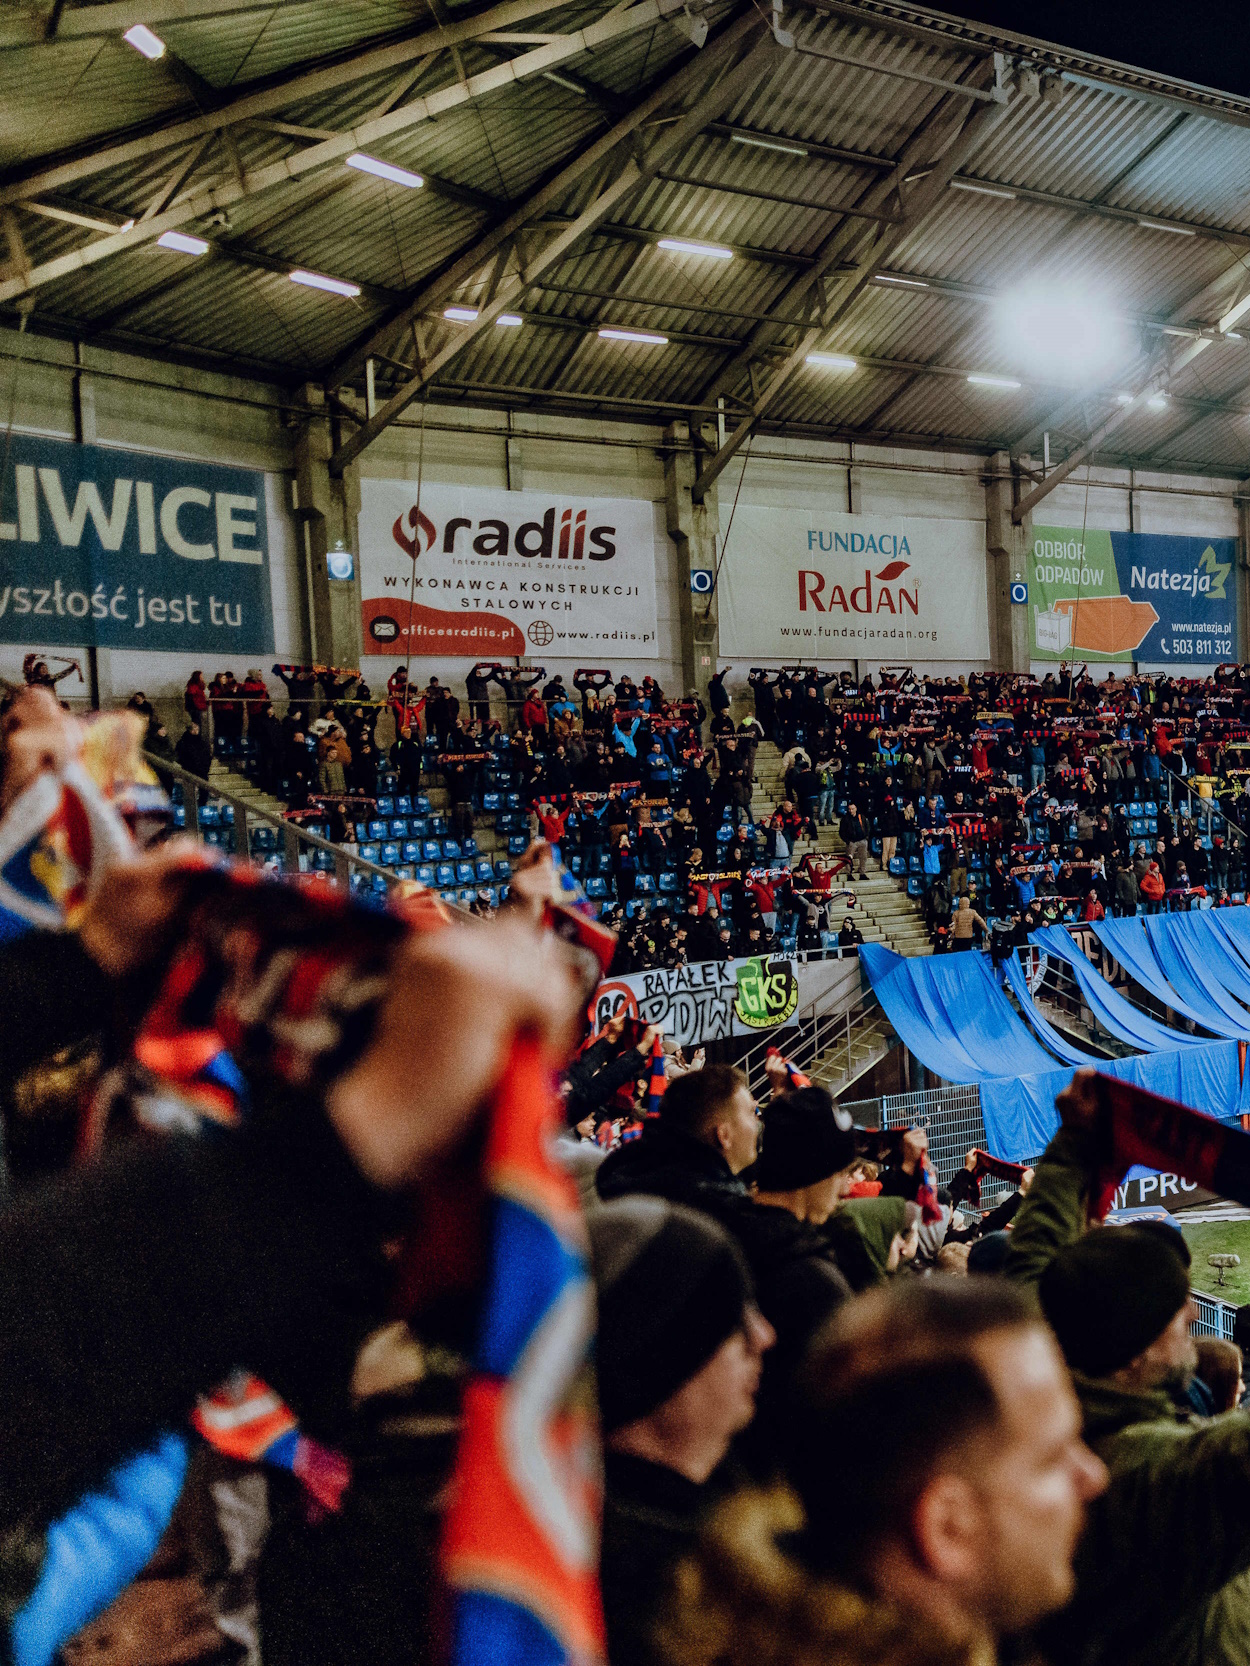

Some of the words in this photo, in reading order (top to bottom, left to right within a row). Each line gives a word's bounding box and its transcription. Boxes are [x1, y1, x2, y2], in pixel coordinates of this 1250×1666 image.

[442, 505, 617, 562] radiis
[807, 530, 911, 558] FUNDACJA
[1034, 538, 1086, 561] ODBIÓR
[452, 557, 531, 568] International
[537, 561, 587, 571] Services
[1035, 563, 1105, 586] ODPADÓW
[384, 576, 509, 592] WYKONAWCA
[519, 582, 640, 596] KONSTRUKCJI
[1130, 565, 1211, 598] Natezja
[134, 589, 201, 628] jest
[209, 595, 242, 626] tu
[461, 597, 573, 612] STALOWYCH
[556, 630, 656, 642] www.radiis.pl
[780, 625, 938, 642] www.fundacjaradan.org
[1171, 622, 1232, 635] www.natezja.pl
[1173, 640, 1193, 655] 503
[1196, 640, 1212, 655] 811
[1214, 640, 1232, 655] 312
[643, 960, 730, 999] RAFAŁEK
[741, 973, 787, 1012] GKS
